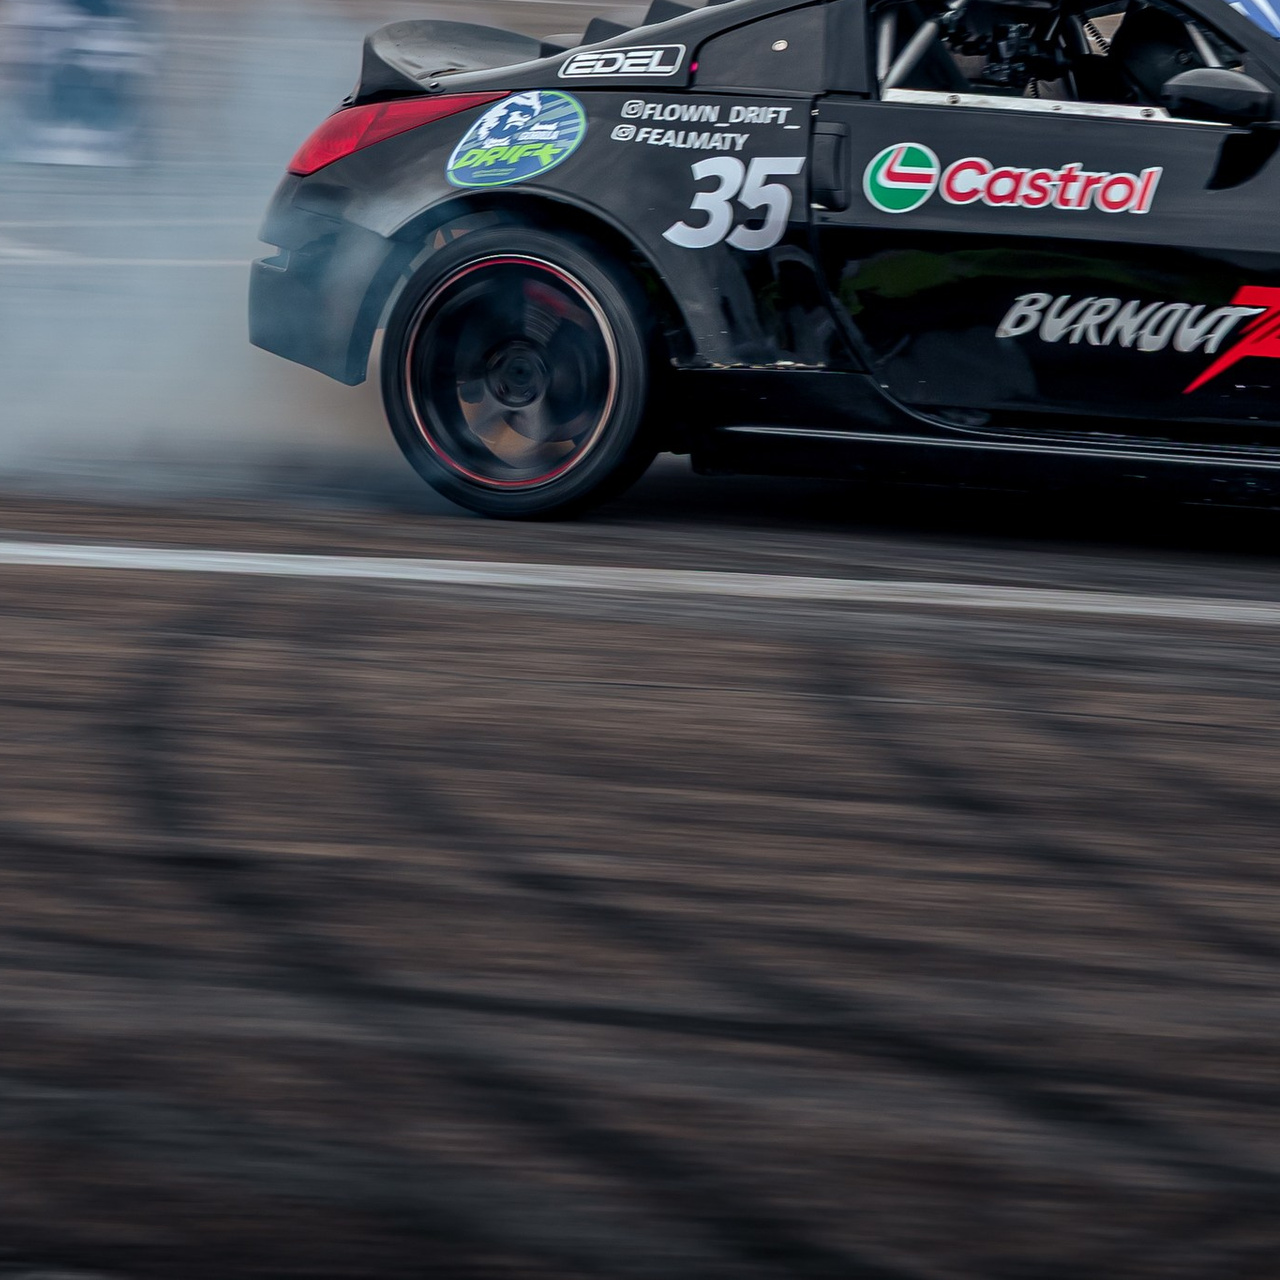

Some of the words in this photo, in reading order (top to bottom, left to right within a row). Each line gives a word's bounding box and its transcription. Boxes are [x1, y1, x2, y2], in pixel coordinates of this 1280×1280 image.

[565, 50, 676, 75] EDEL
[635, 127, 750, 151] FEALMATY
[452, 143, 564, 170] DRIFT
[939, 156, 1164, 214] Castrol
[662, 156, 806, 251] 35
